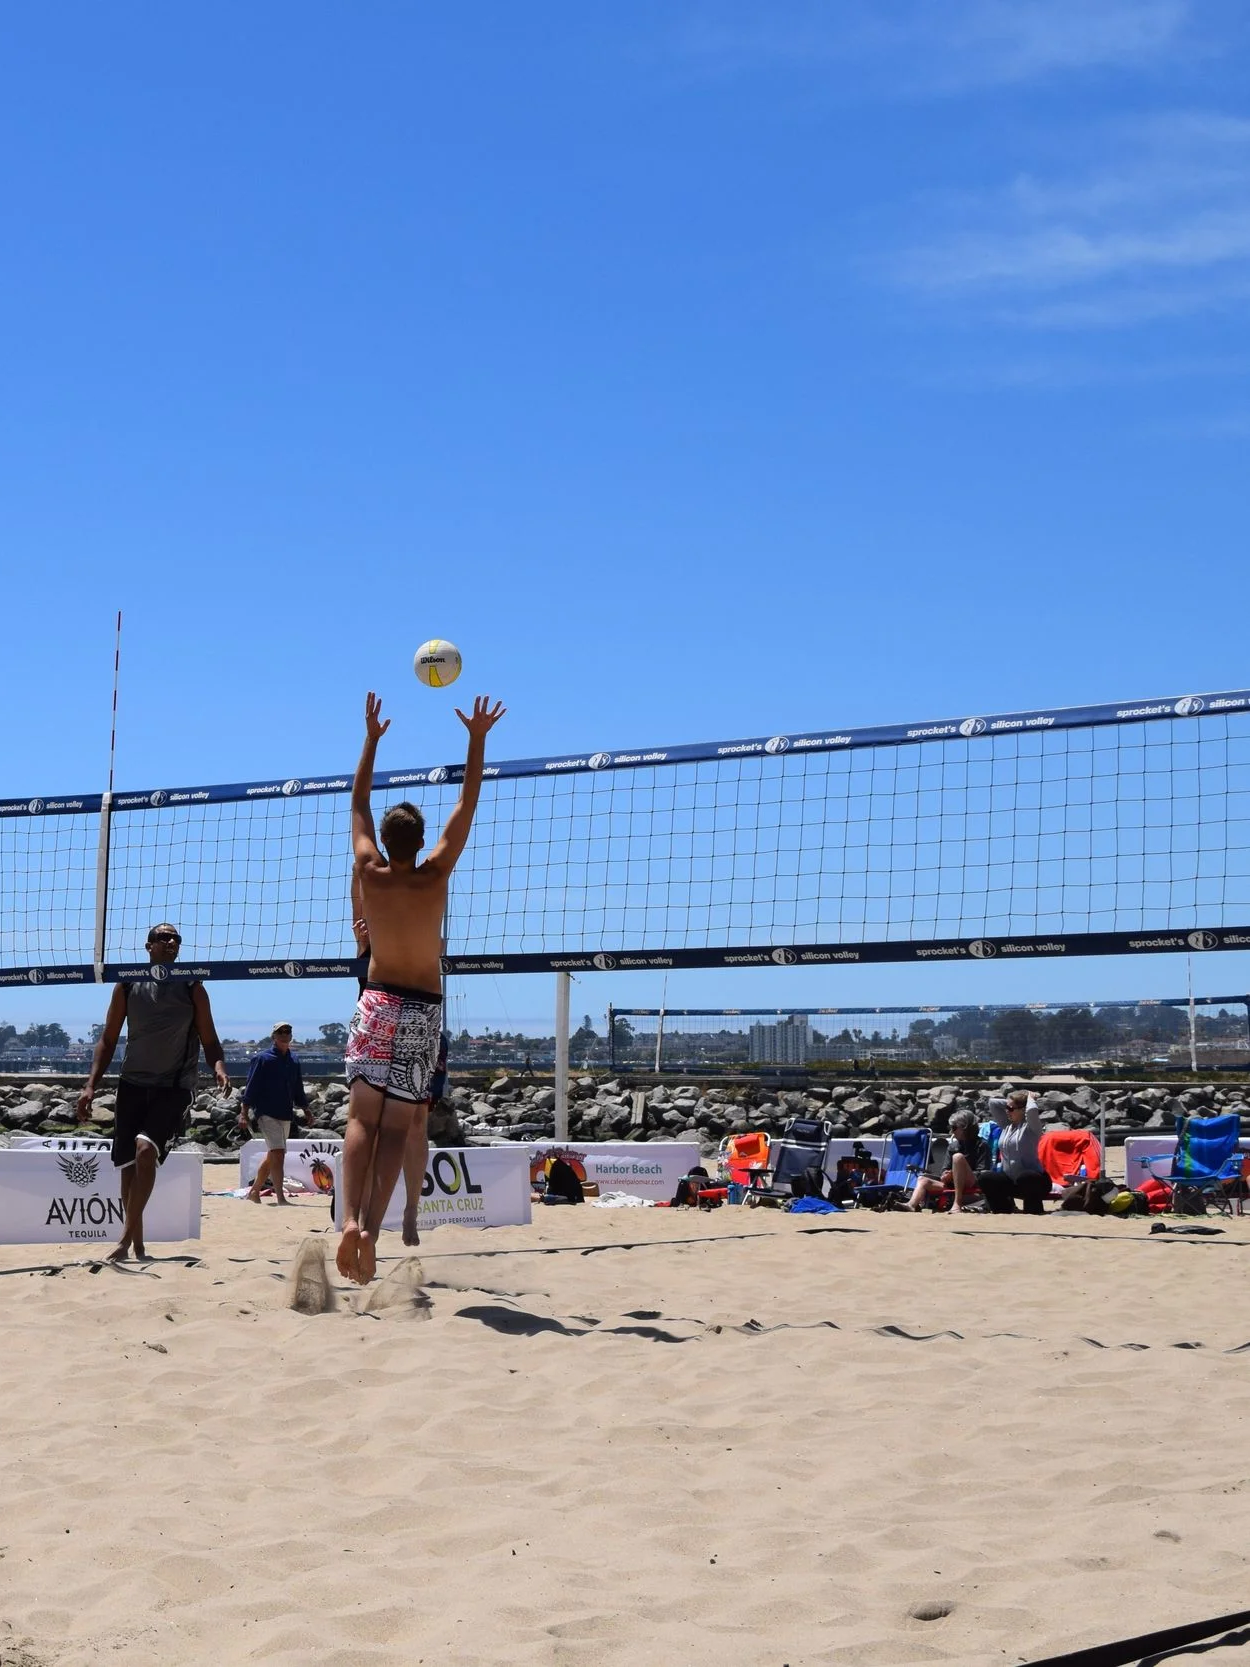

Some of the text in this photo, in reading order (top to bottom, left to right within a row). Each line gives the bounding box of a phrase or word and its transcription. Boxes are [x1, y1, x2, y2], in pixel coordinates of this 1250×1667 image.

[1116, 704, 1171, 718] sprocket's
[1209, 699, 1245, 708] silicon
[906, 716, 1054, 737] sprocket's silicon volley
[718, 736, 852, 755] sprocket's silicon volley
[545, 752, 667, 770] sprocket's silicon volley
[389, 773, 426, 783] sprocket's
[482, 768, 500, 776] olley
[246, 780, 348, 795] sprocket's silicon volley
[118, 792, 210, 806] sprocket's silicon volley
[916, 942, 1066, 956] sprocket's silicon volley
[1128, 935, 1250, 949] sprocket's silico
[550, 956, 673, 968] sprocket's silicon volley
[724, 950, 860, 963] sprocket's silicon volley
[248, 965, 350, 975] sprocket's silicon volley
[455, 961, 504, 970] silicon volley
[596, 1164, 662, 1174] Harbor Beach
[417, 1198, 484, 1213] SANTA CRUZ
[68, 1230, 107, 1238] TEQUILA
